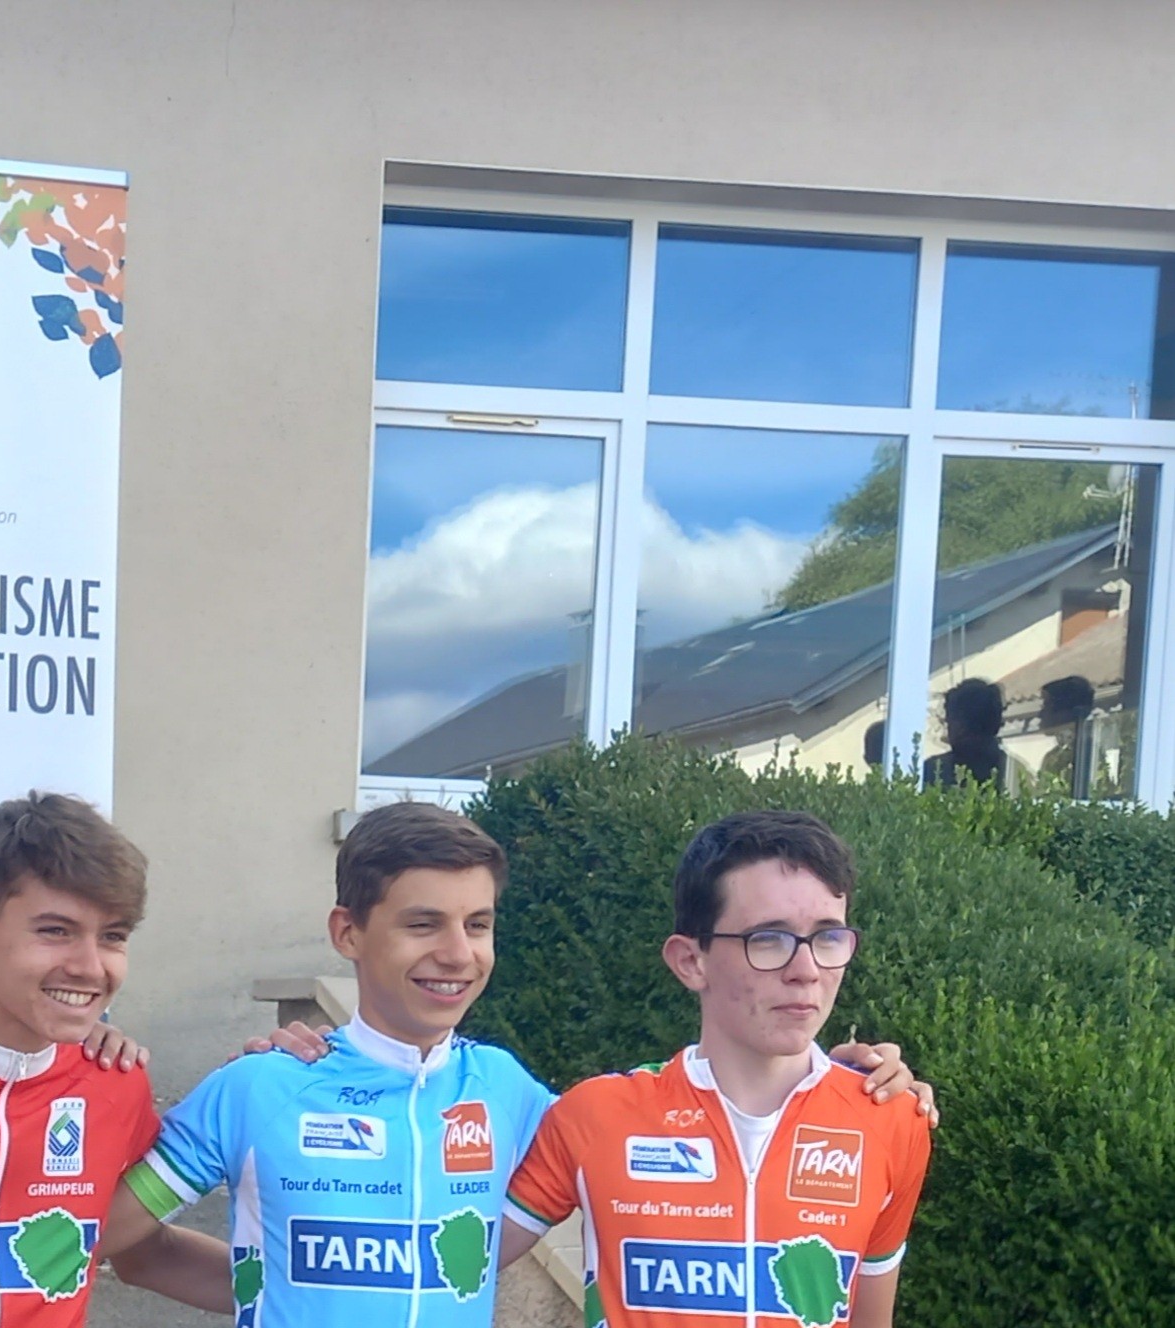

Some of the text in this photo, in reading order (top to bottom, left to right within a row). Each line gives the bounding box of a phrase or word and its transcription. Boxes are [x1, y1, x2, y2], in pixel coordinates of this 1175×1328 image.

[444, 1114, 491, 1152] TARN
[794, 1140, 862, 1178] TARN
[28, 1182, 95, 1197] GRIMPEUR
[280, 1177, 403, 1195] Tour du Tarn cadet
[450, 1181, 490, 1195] LEADER
[610, 1199, 734, 1218] Tour du Tarn cadet
[798, 1209, 847, 1227] Cadet 1
[298, 1235, 414, 1274] TARN
[631, 1257, 746, 1298] TARN
